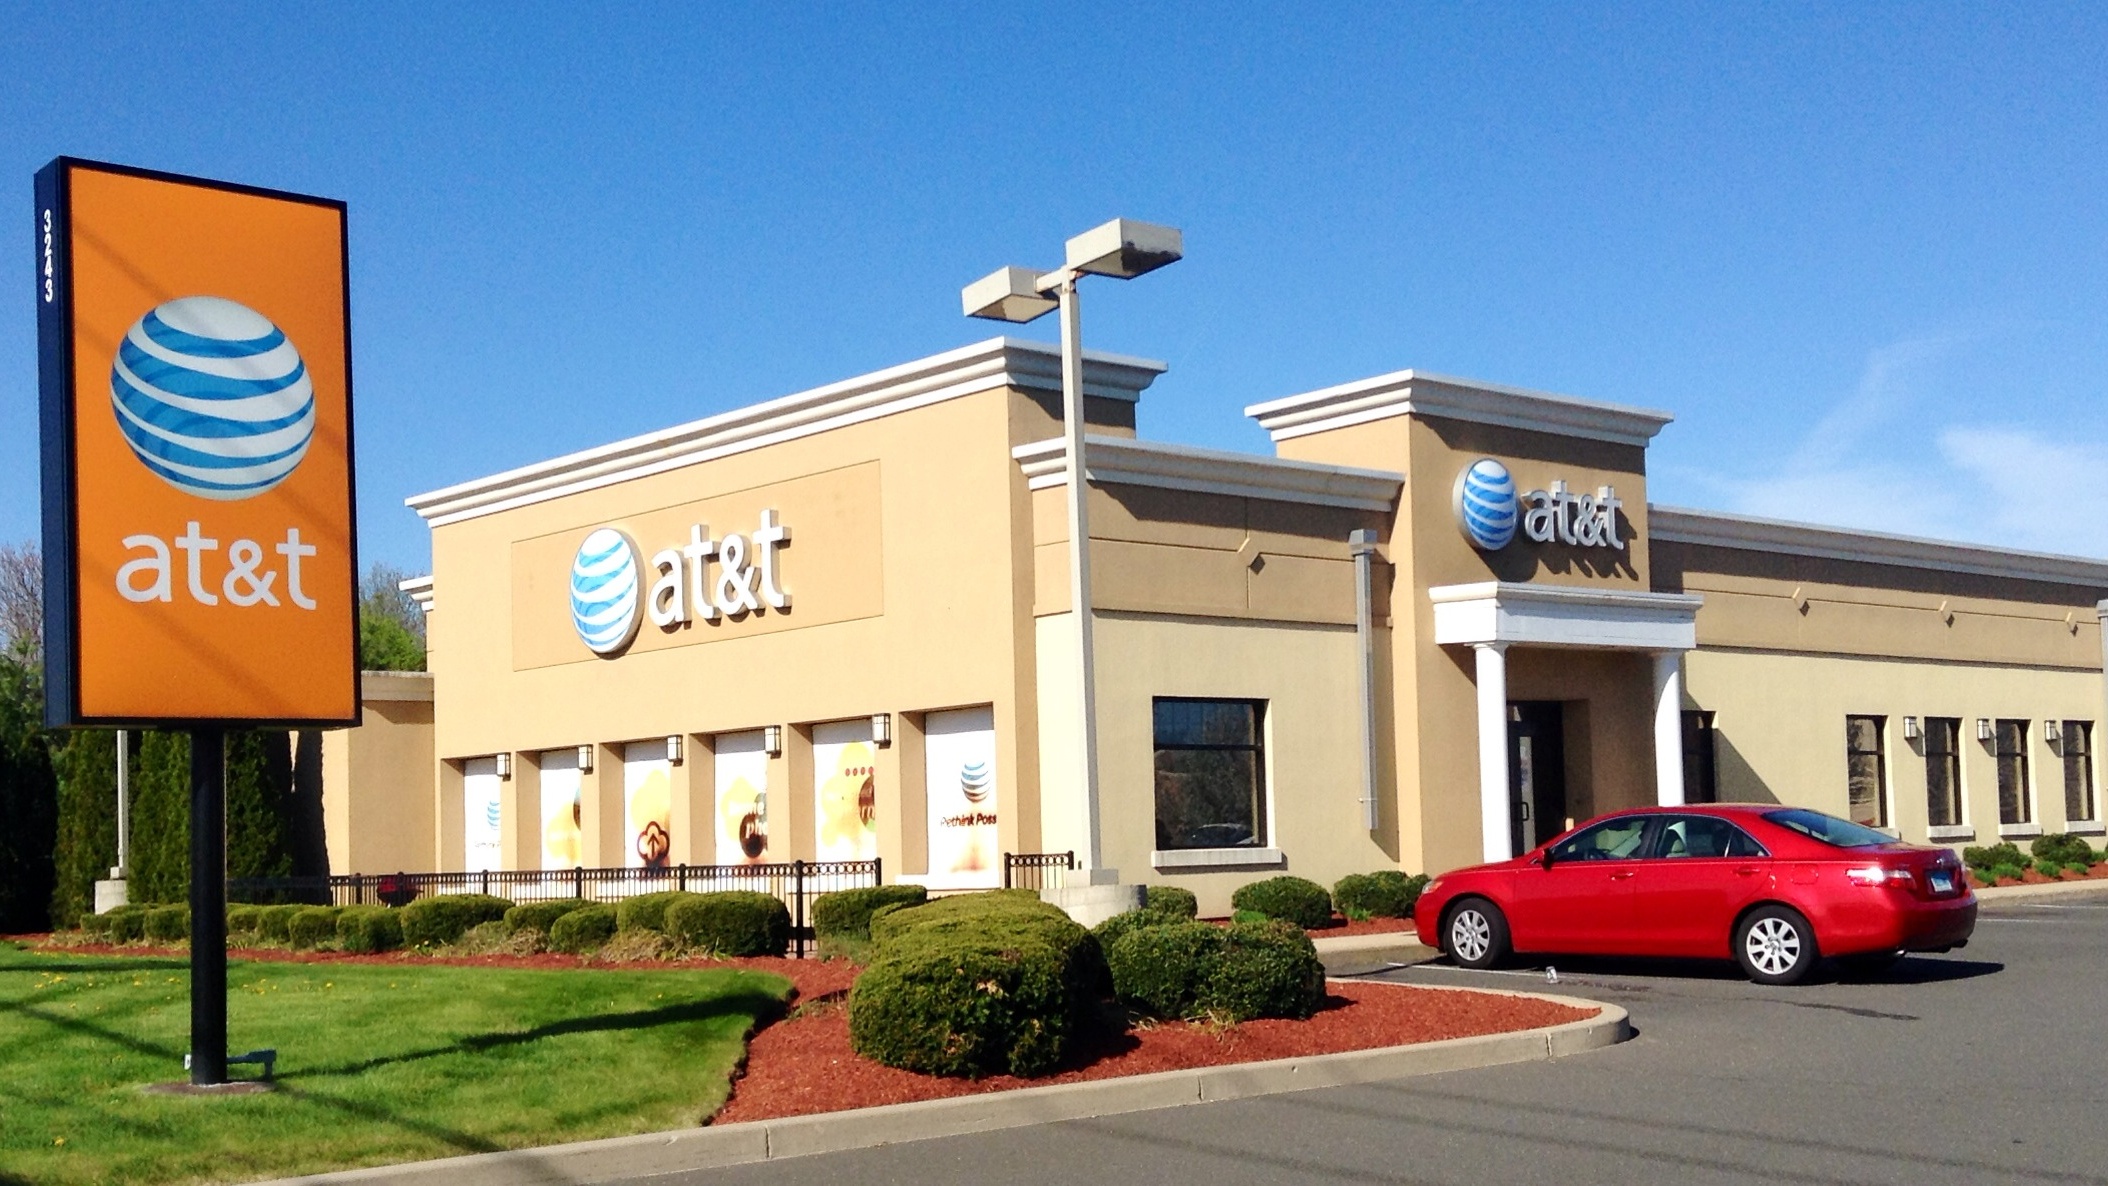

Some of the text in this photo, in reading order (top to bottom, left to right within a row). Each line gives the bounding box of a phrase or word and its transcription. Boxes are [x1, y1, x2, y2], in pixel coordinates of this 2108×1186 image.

[44, 208, 53, 303] 3243
[1522, 480, 1623, 551] at&t
[115, 521, 317, 611] at&t
[648, 508, 792, 628] at&t
